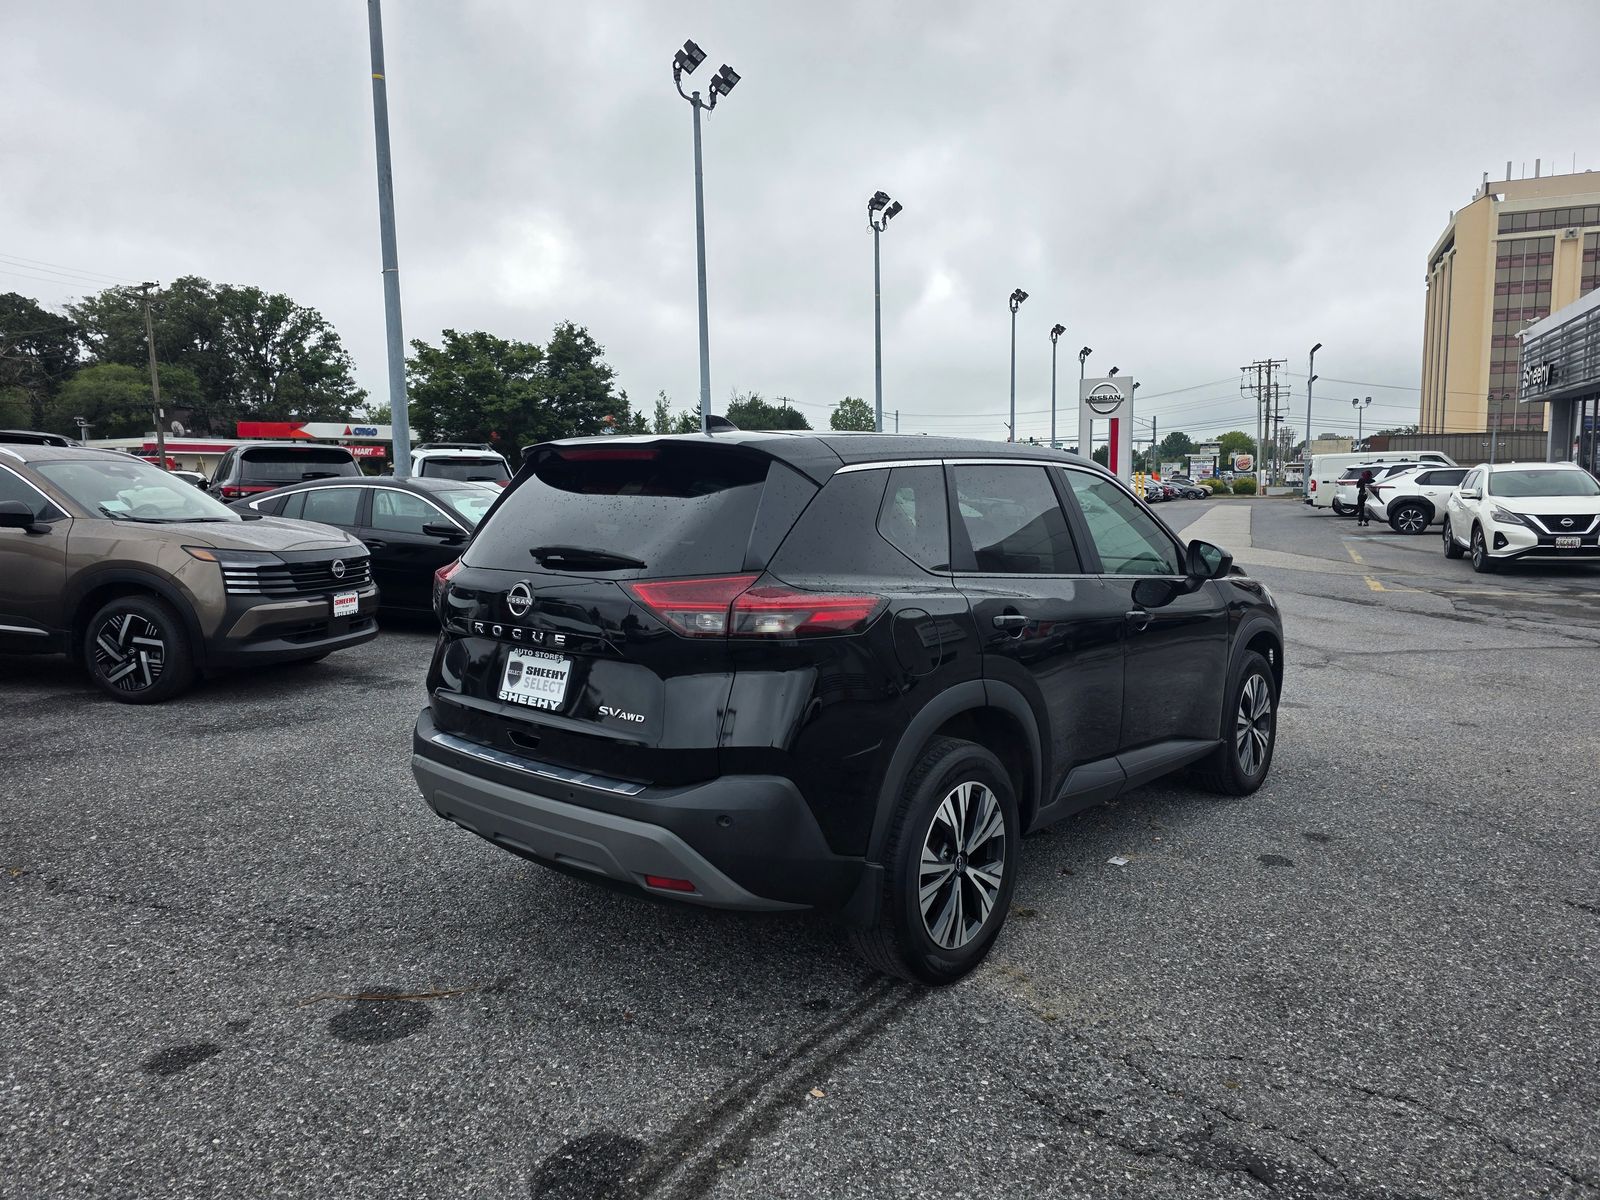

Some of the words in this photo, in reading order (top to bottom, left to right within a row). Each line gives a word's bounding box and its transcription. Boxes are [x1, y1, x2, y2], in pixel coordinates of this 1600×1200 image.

[1524, 361, 1551, 387] Sheehy
[353, 427, 378, 436] CITGO
[507, 597, 532, 605] NISSAN
[474, 622, 566, 646] ROGUE
[514, 648, 533, 656] AUTO
[535, 651, 564, 662] STORES
[526, 666, 567, 680] SHEEHY
[523, 677, 564, 694] SELECT
[499, 690, 560, 711] SHEEHY
[618, 711, 645, 723] AWD
